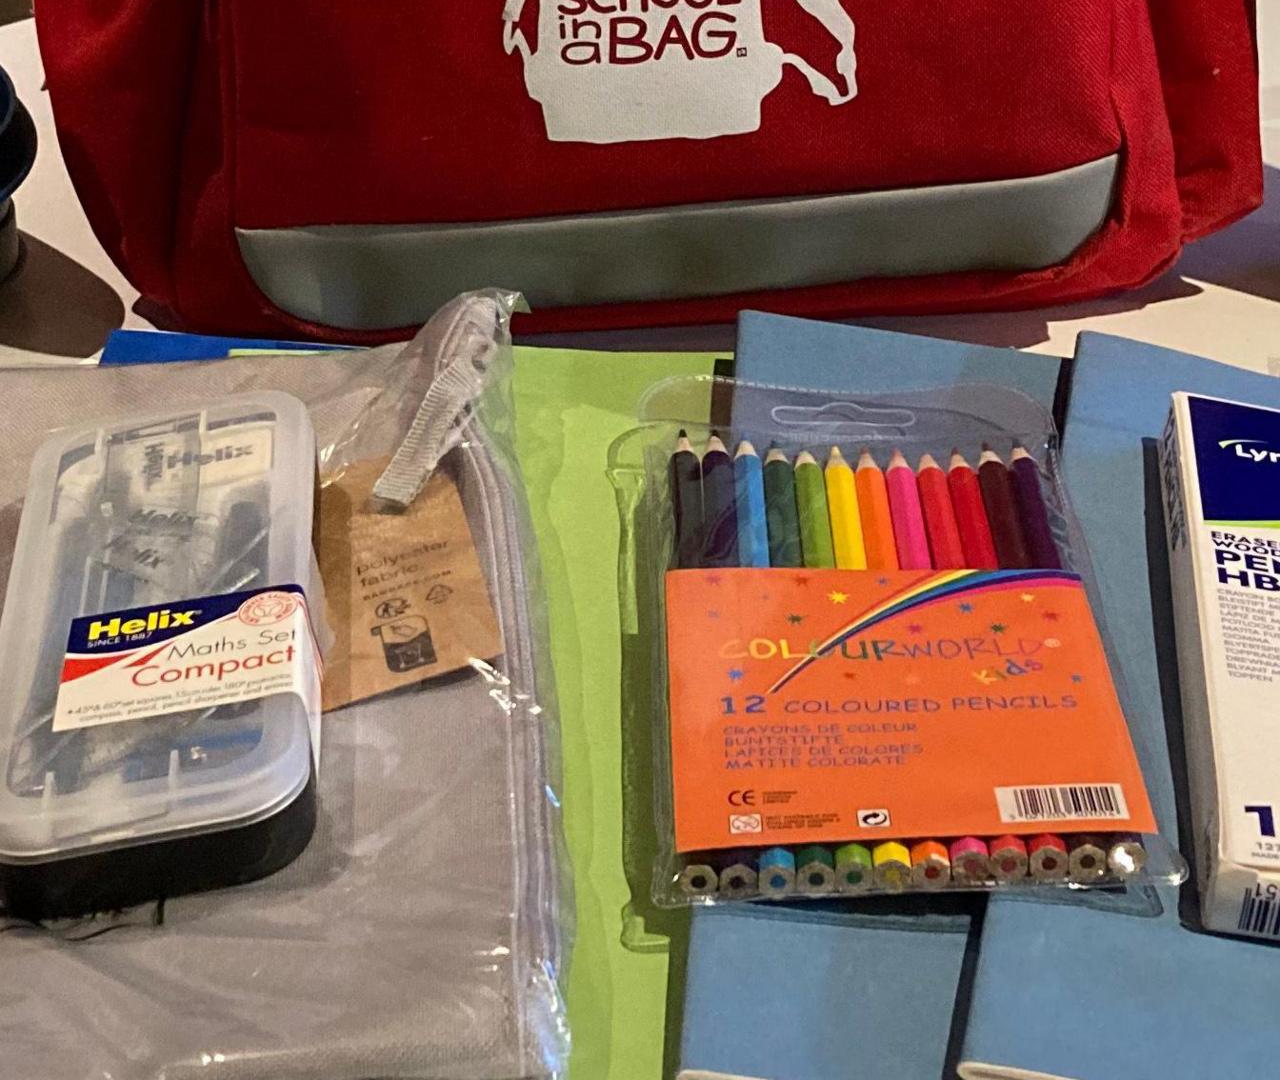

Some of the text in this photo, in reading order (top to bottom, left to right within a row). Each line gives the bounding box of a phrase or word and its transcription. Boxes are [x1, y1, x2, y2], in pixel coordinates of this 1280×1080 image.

[559, 15, 602, 39] in
[560, 12, 738, 65] a BAG
[88, 610, 195, 640] Helix
[87, 635, 121, 648] SINCE
[167, 629, 297, 661] Maths Set
[131, 645, 297, 688] Compact
[720, 695, 1077, 714] 12 COLOURED PENCILS
[723, 724, 812, 736] CRAYONS
[817, 723, 840, 734] DE
[724, 735, 844, 747] BUNTSTIFTE
[838, 744, 924, 756] COLORES
[726, 756, 906, 769] MATITE COLORATE
